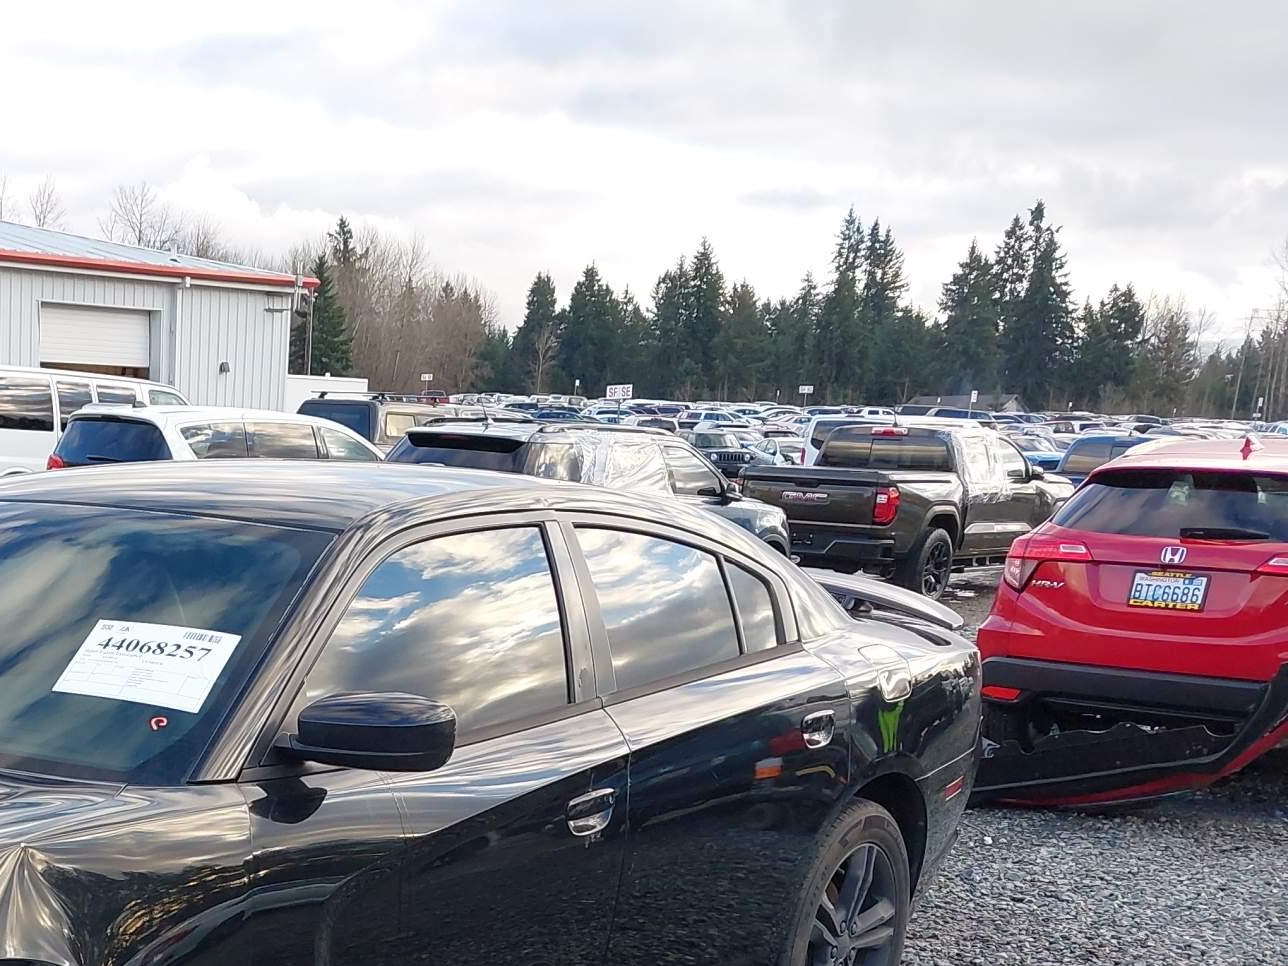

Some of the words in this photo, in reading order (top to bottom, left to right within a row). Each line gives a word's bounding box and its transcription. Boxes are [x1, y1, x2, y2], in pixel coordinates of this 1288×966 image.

[621, 386, 631, 397] SE
[781, 491, 831, 504] GMC
[1132, 582, 1201, 604] BTC6686
[1128, 599, 1200, 611] CARTER
[97, 636, 213, 662] 44068257
